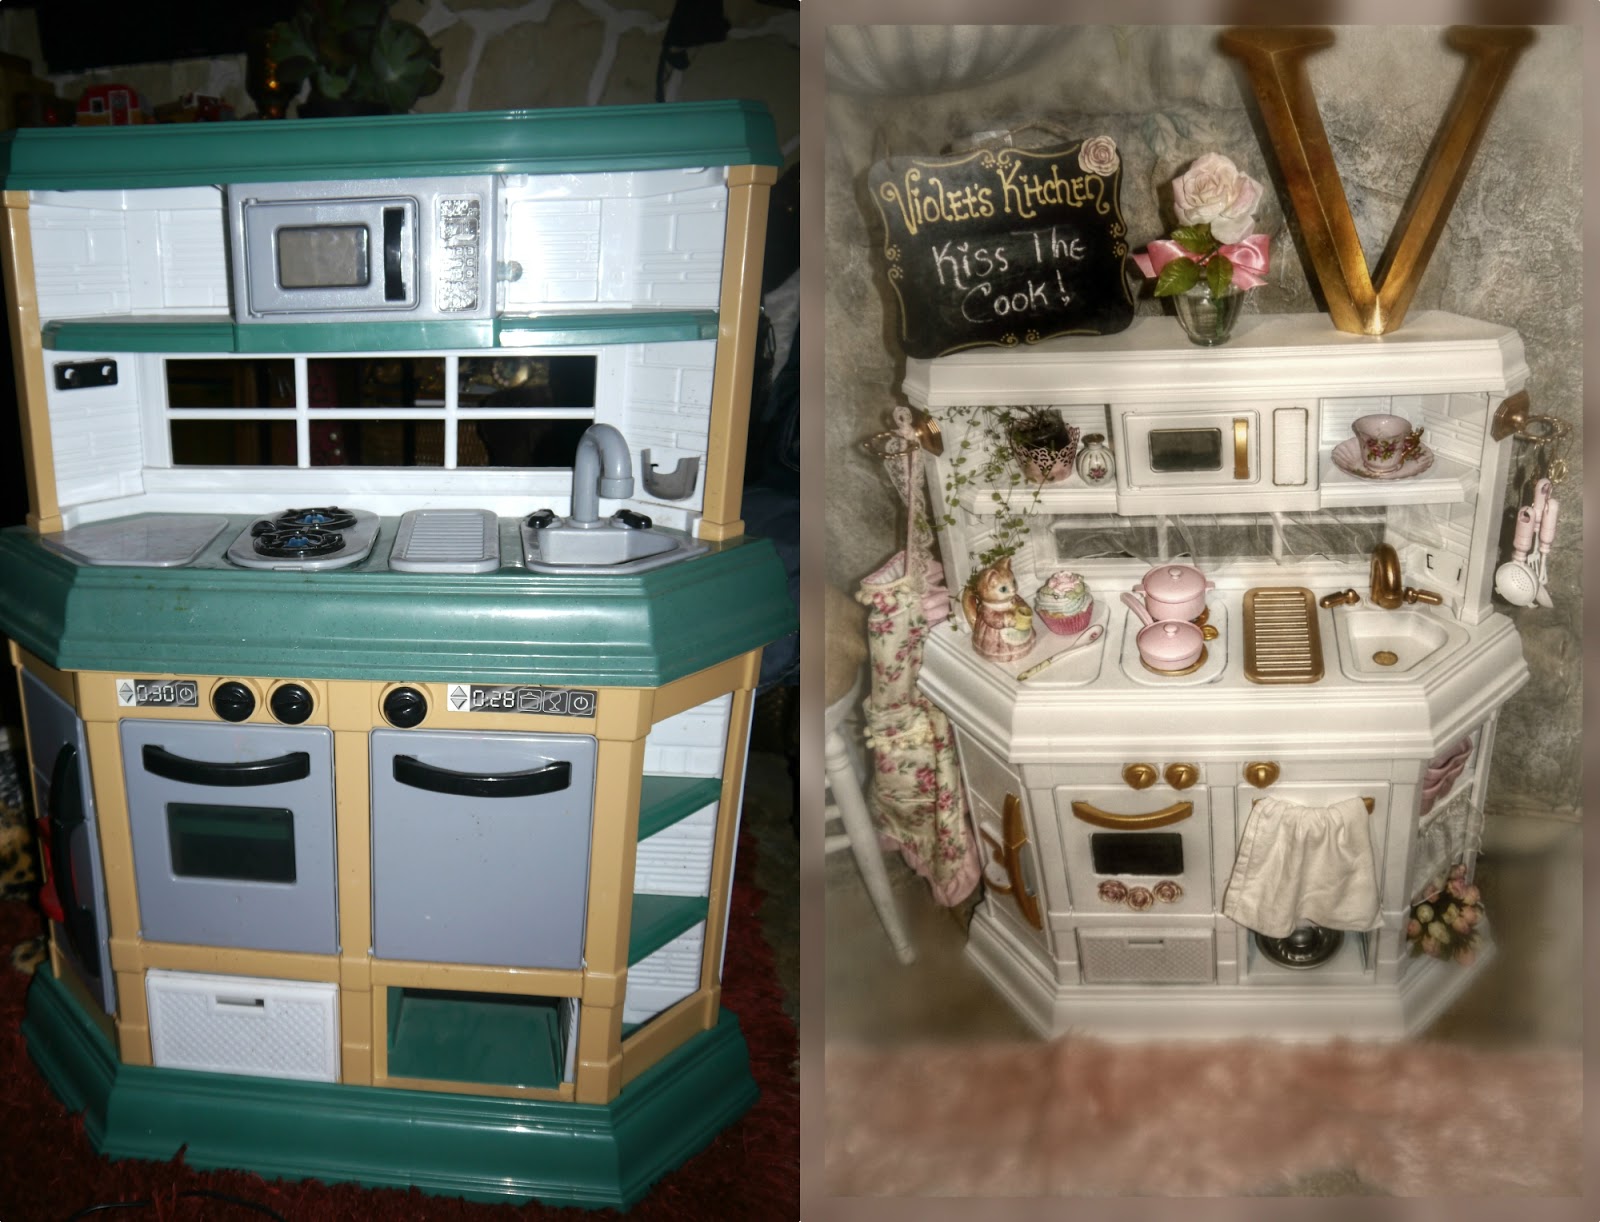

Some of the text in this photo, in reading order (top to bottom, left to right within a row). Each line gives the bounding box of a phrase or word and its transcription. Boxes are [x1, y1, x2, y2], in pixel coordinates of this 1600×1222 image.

[1218, 26, 1536, 335] V
[932, 227, 1085, 290] Kiss The
[136, 684, 175, 702] 0:30
[472, 689, 515, 708] 0:28
